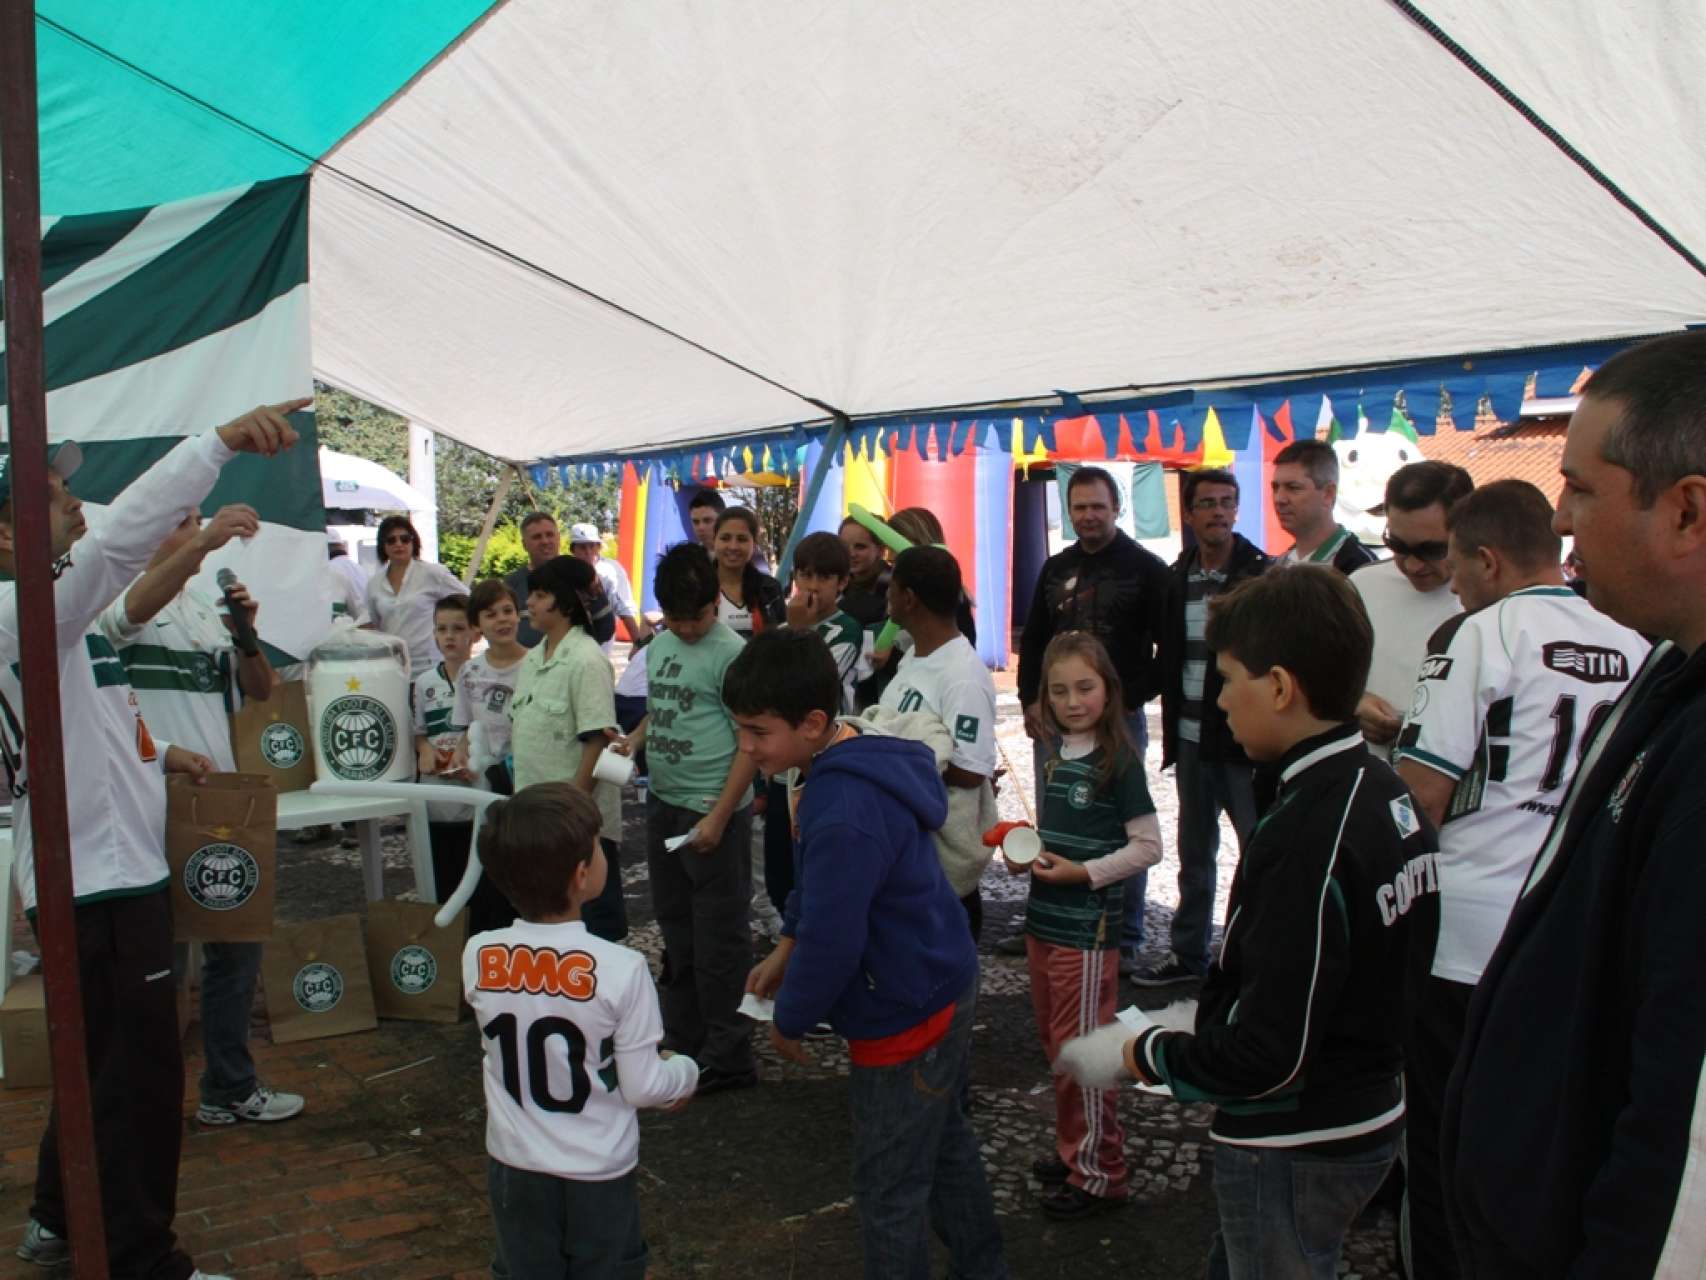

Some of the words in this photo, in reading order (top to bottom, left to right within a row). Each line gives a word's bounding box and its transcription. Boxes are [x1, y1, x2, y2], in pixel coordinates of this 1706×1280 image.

[1584, 654, 1623, 677] TIM
[334, 728, 380, 750] CFC
[201, 868, 242, 885] CFC
[477, 943, 597, 1002] BMG
[483, 1012, 591, 1114] 10
